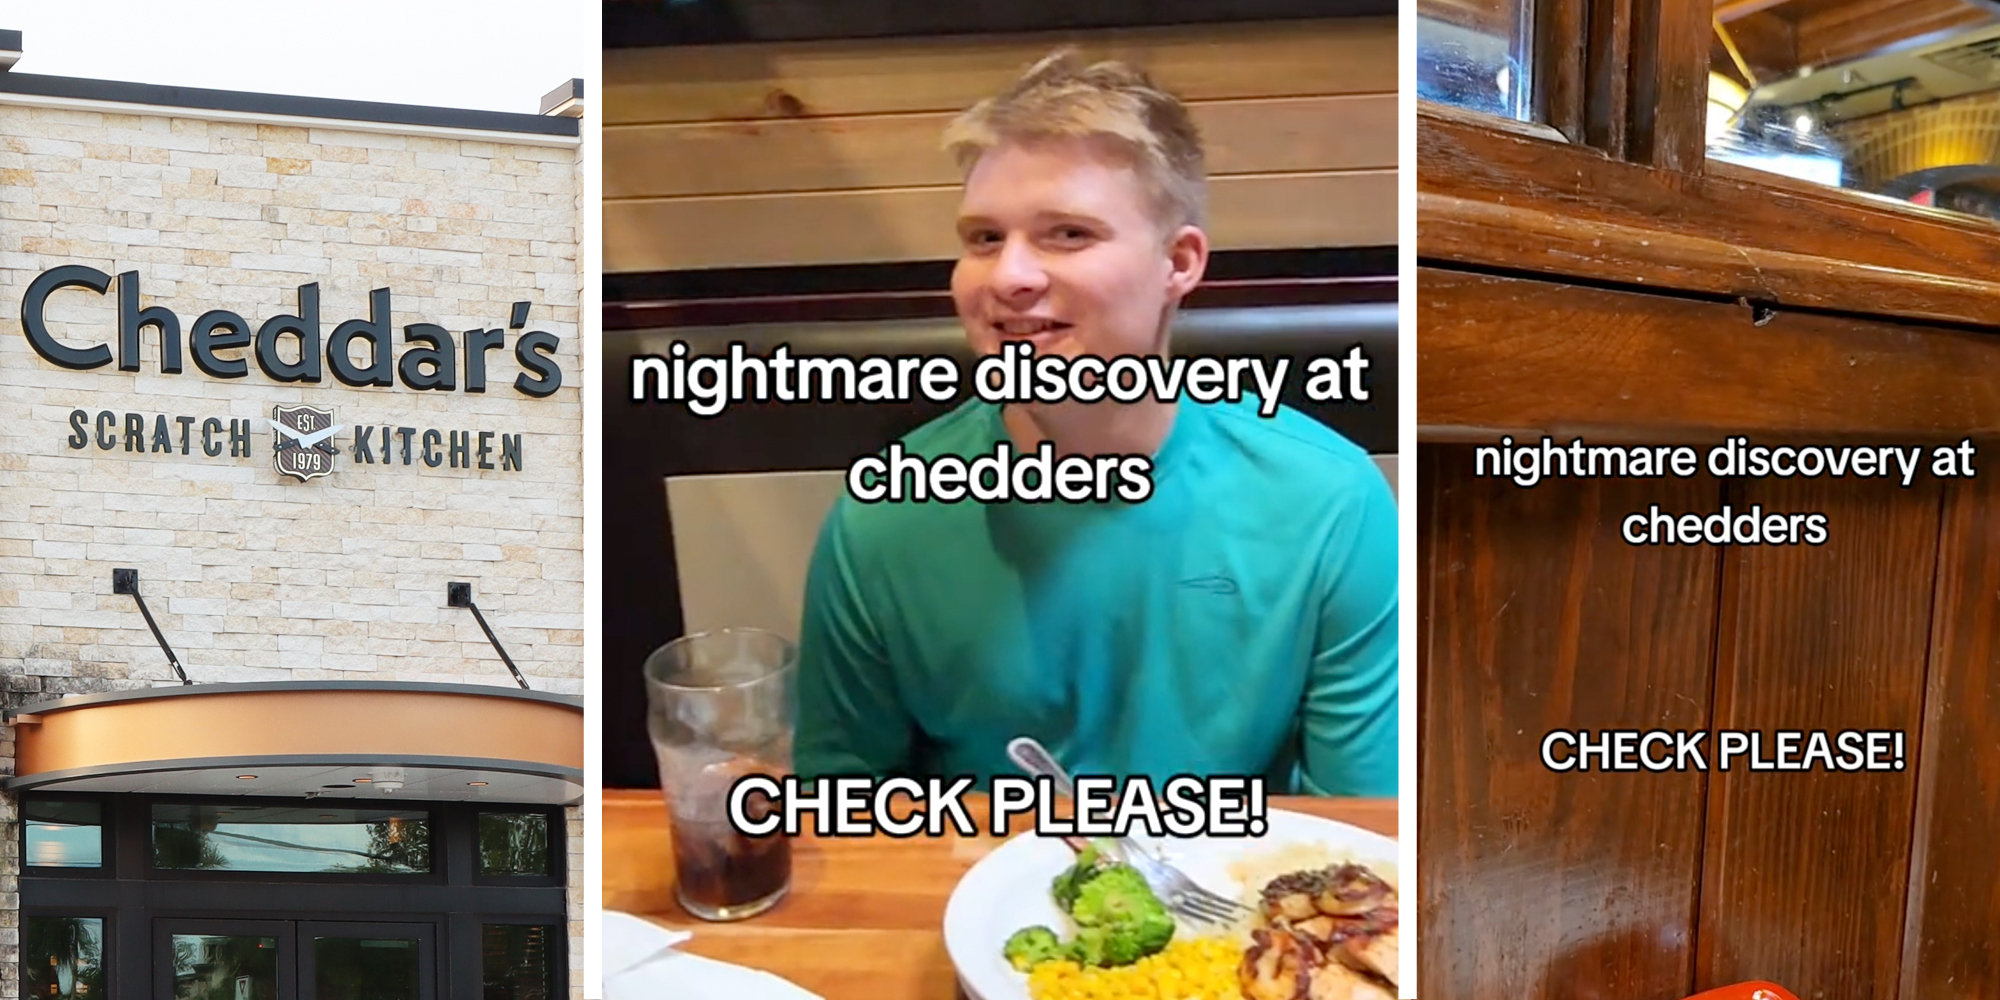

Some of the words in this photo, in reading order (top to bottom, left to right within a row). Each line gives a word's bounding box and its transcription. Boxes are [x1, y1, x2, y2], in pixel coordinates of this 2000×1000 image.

[21, 264, 562, 398] Cheddar's
[68, 409, 252, 458] SCRATCH
[353, 424, 523, 472] KITCHEN
[297, 413, 316, 432] EST.
[293, 452, 321, 471] 1979
